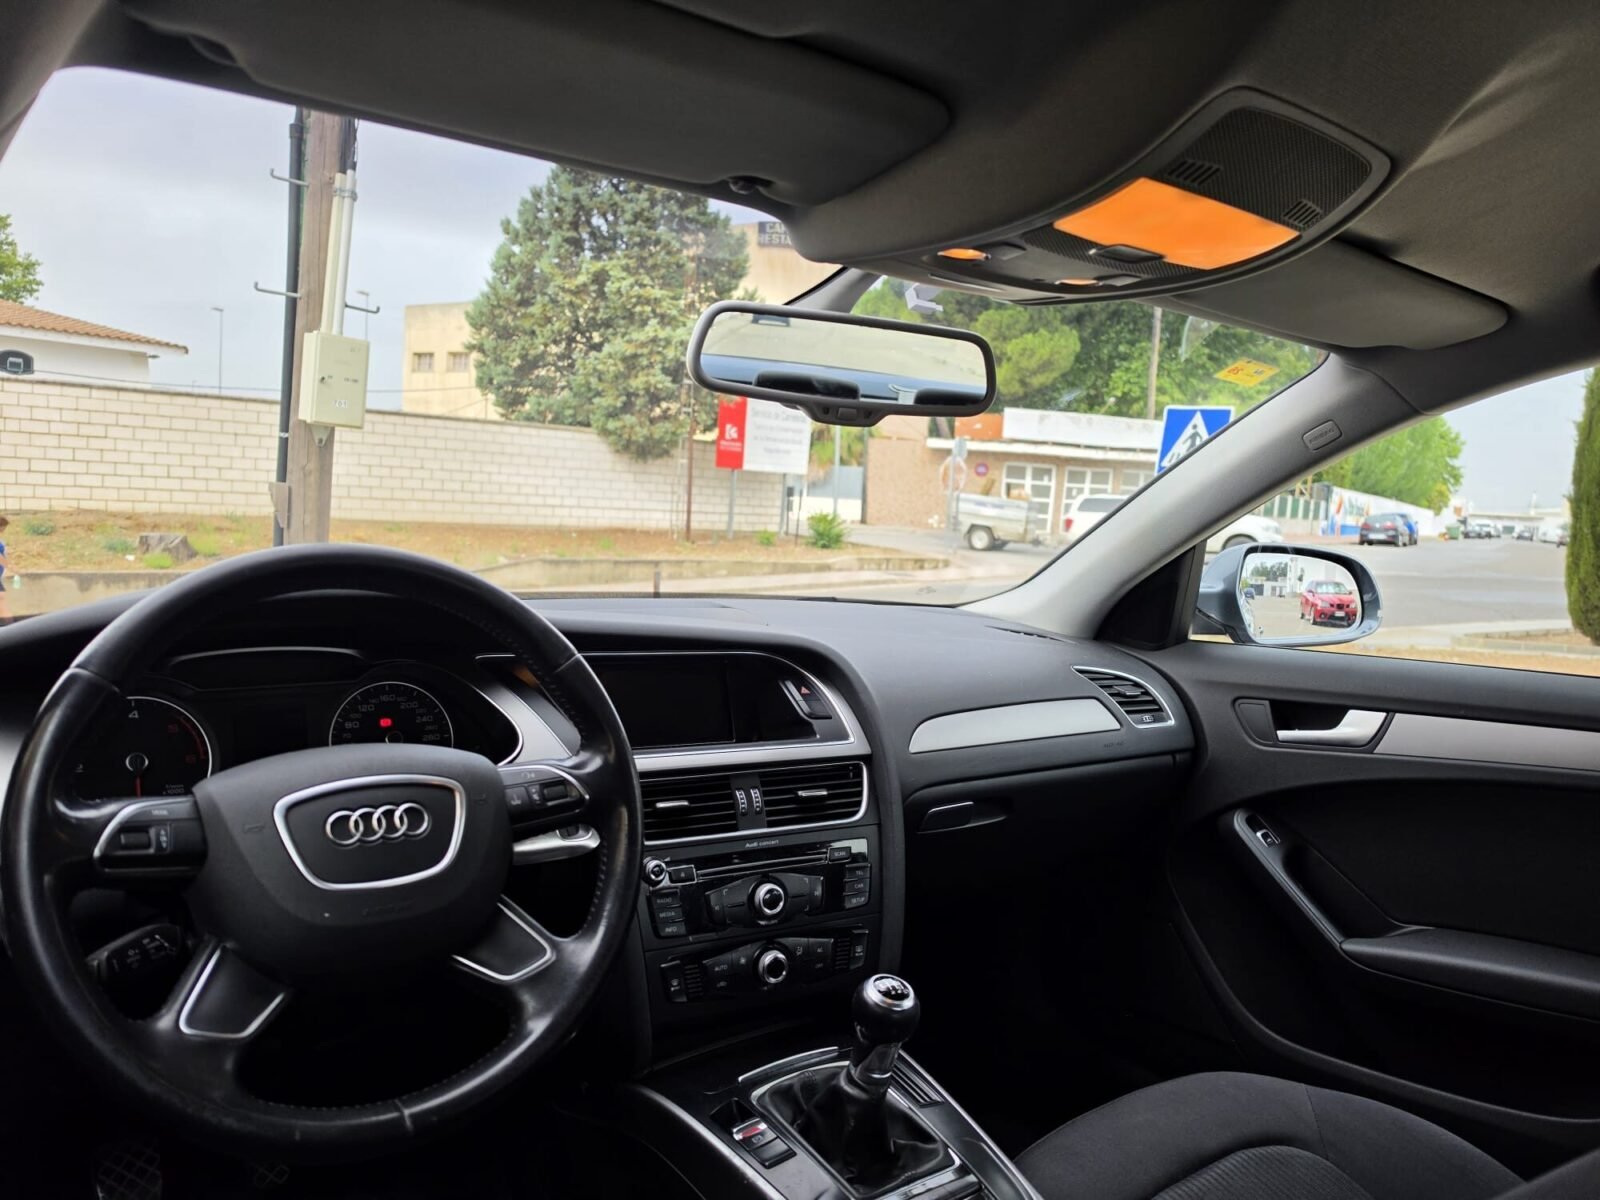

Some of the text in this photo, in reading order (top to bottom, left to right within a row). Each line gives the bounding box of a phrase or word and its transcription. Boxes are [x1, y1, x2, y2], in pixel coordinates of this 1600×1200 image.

[127, 709, 140, 719] 4
[416, 715, 433, 723] 240
[759, 839, 779, 847] concert
[851, 896, 865, 904] SETUP
